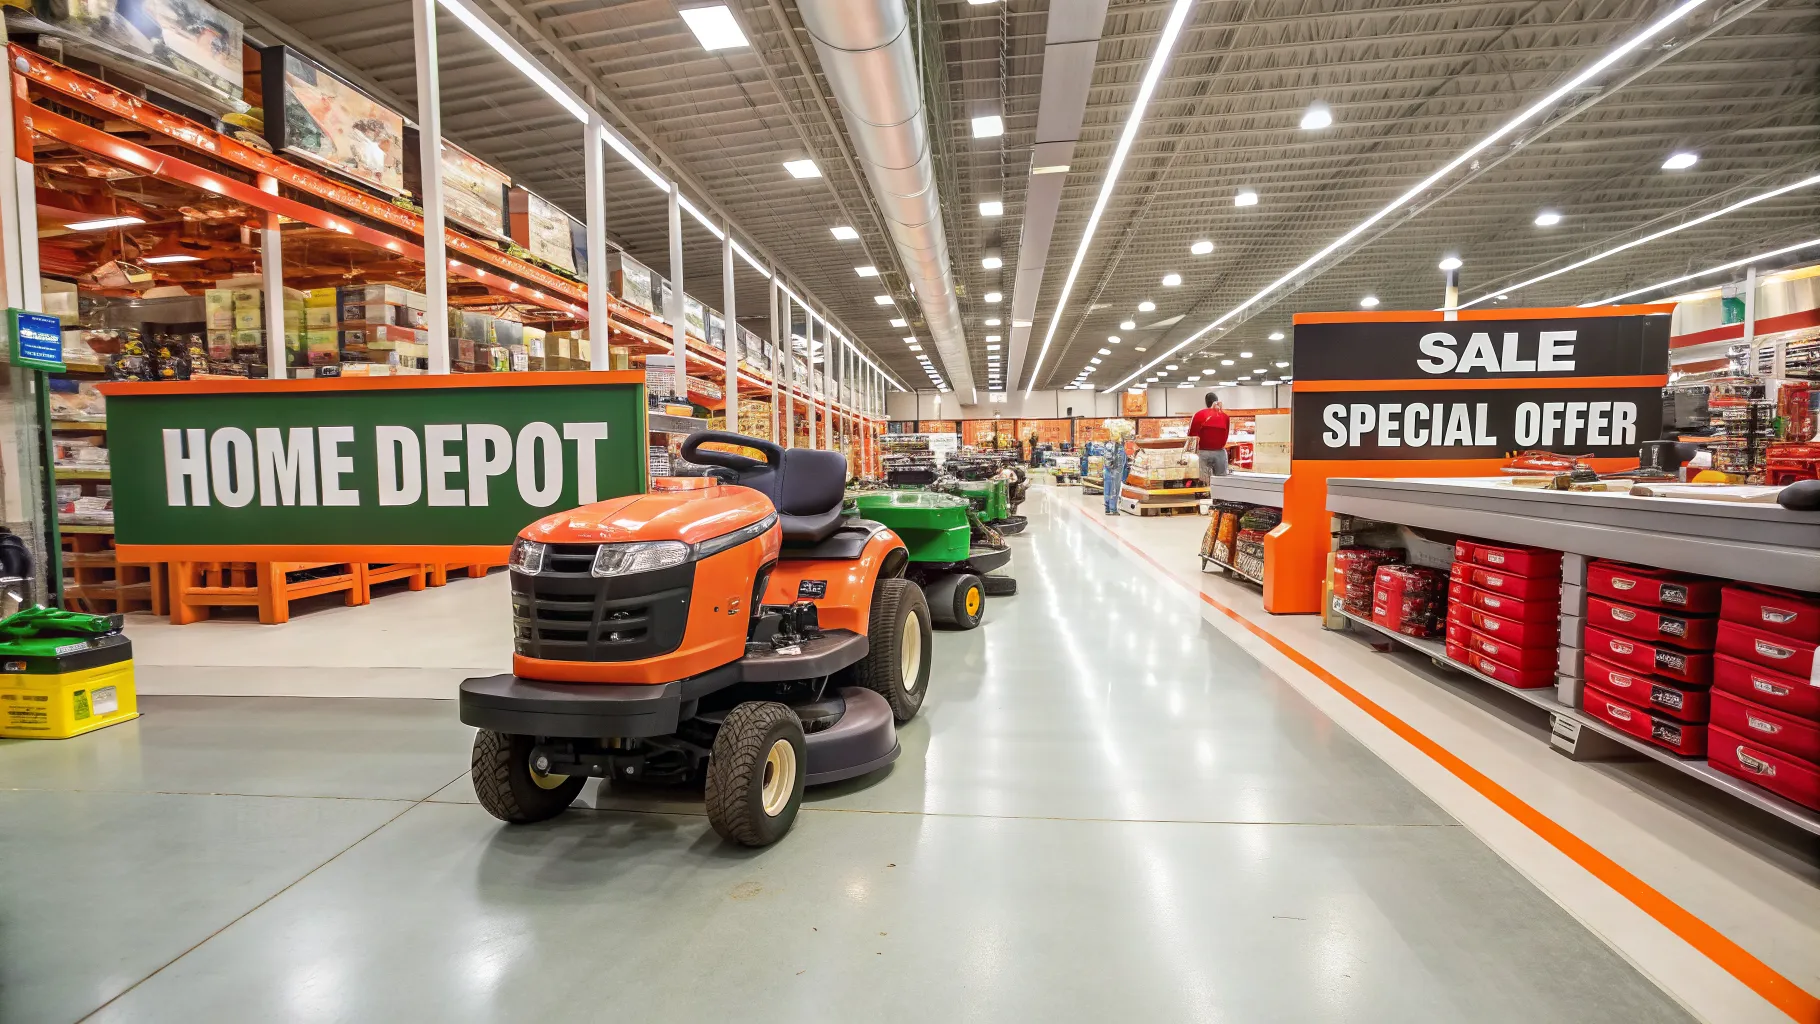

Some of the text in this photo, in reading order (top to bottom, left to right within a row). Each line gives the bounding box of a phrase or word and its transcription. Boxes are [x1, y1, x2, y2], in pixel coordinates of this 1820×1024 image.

[1416, 331, 1578, 374] SALE
[1322, 401, 1638, 448] SPECIAL OFFER
[162, 421, 609, 508] HOME DEPOT
